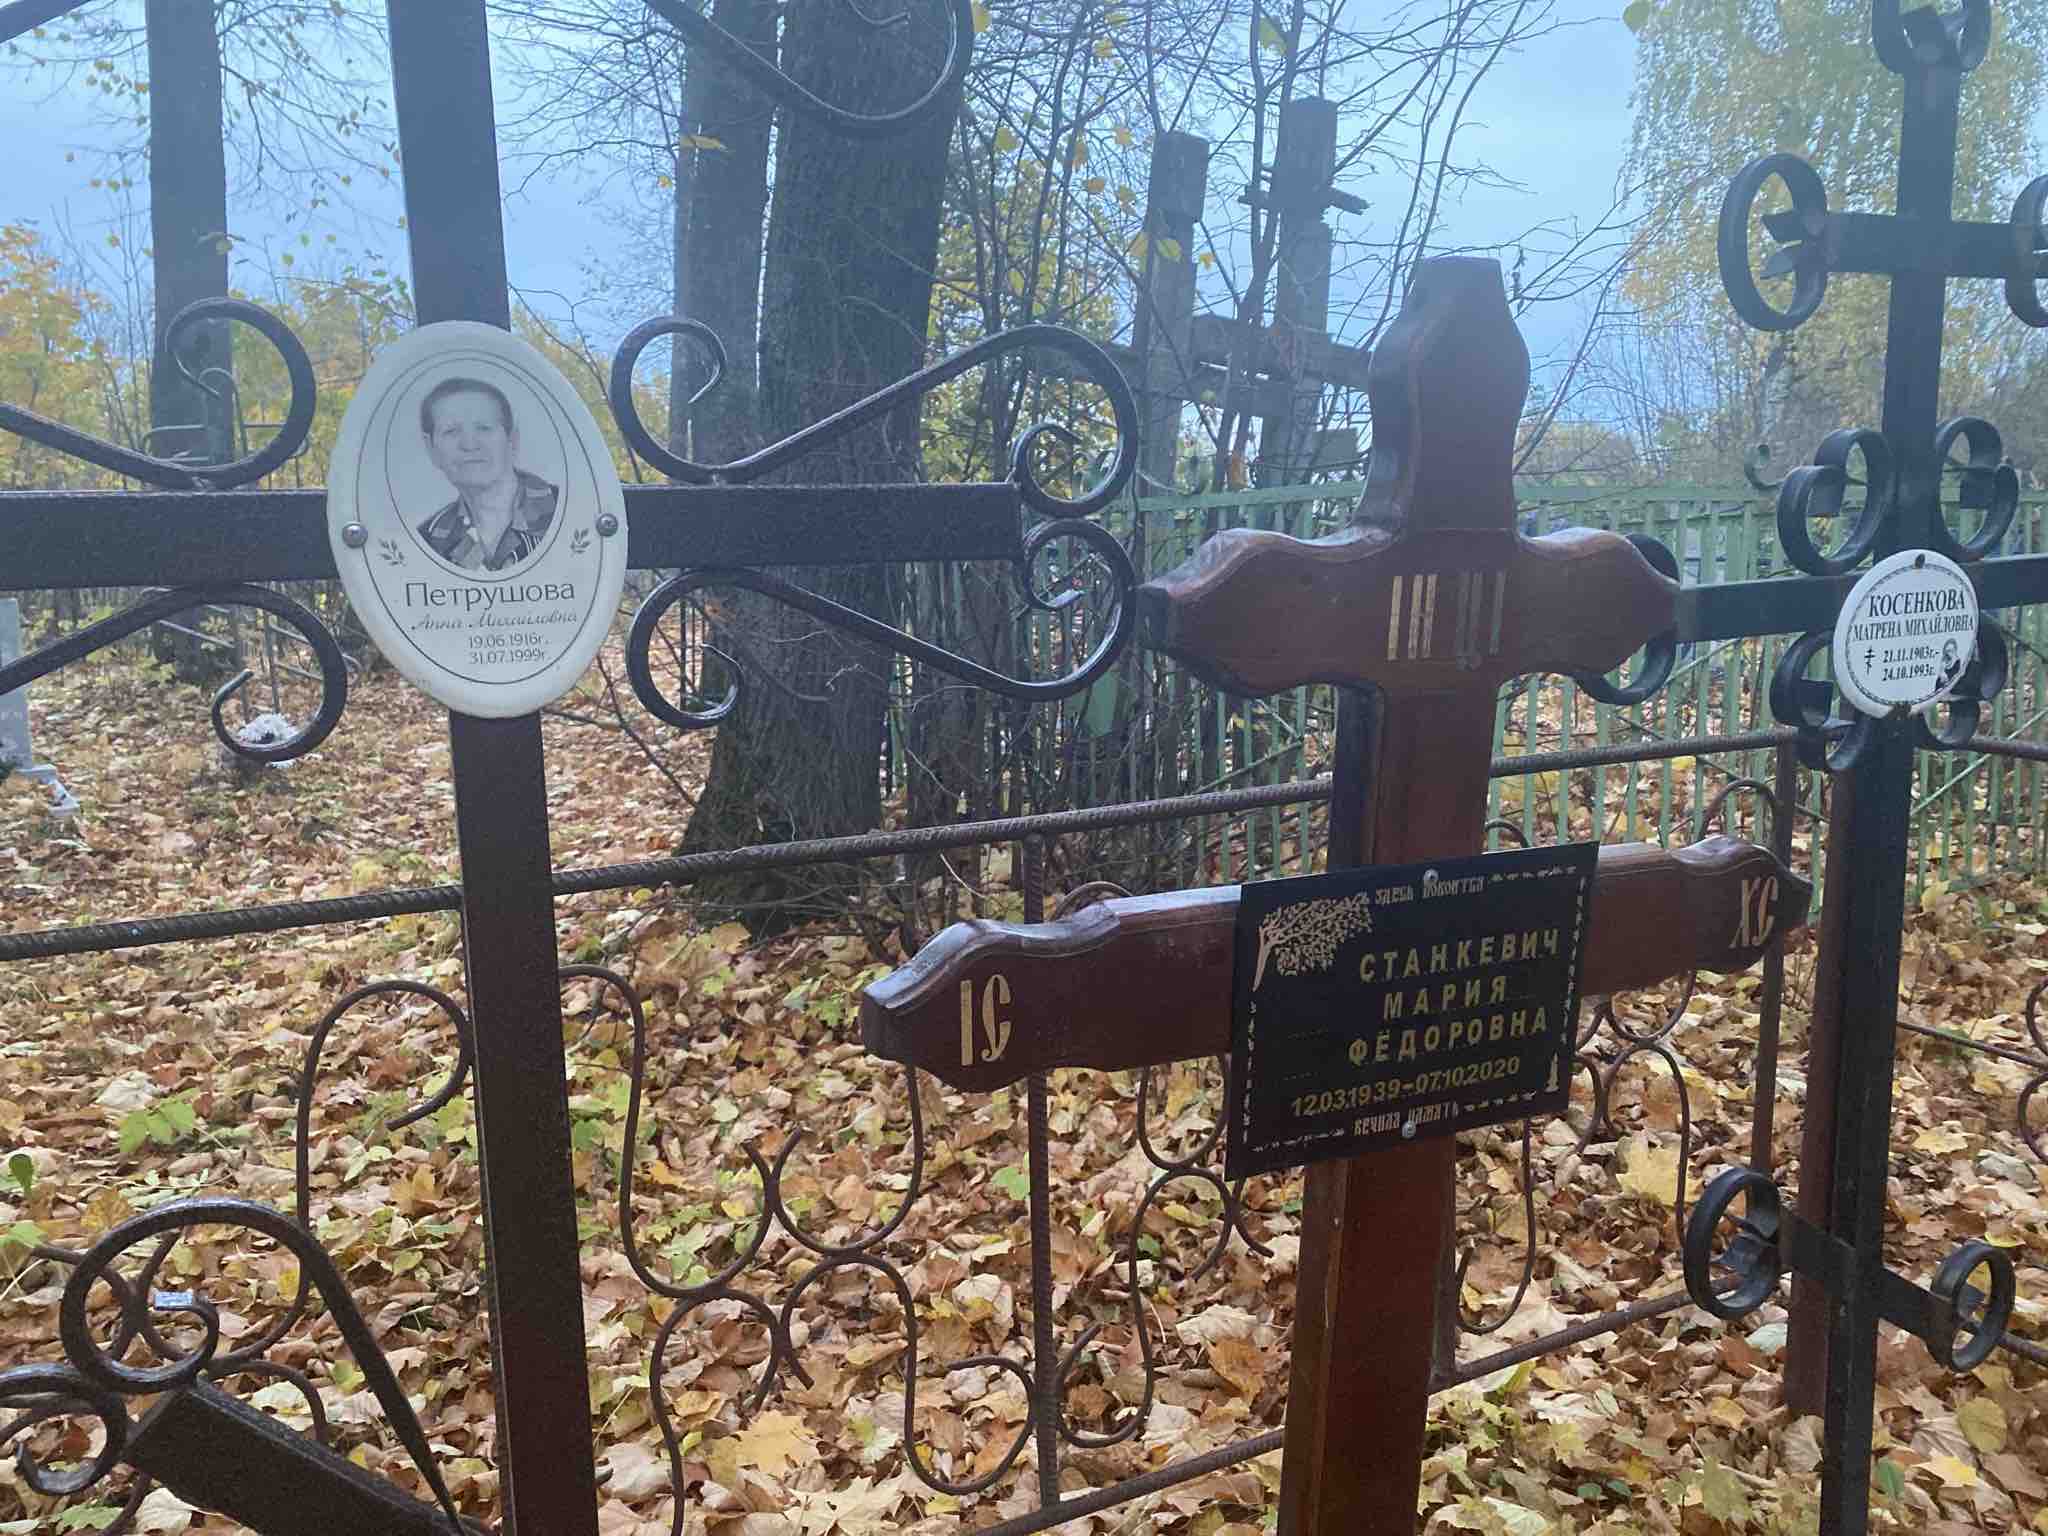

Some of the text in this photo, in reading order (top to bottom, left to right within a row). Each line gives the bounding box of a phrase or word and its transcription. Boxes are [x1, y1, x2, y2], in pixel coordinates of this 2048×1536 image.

[405, 583, 576, 611] Петрушова
[1869, 588, 1966, 618] КОСЕНКОВА
[1359, 929, 1561, 983] СТАНКЕВИЧ
[1383, 974, 1507, 1022] МАРИЯ
[1348, 1010, 1547, 1067] ФЁДОРОВНА
